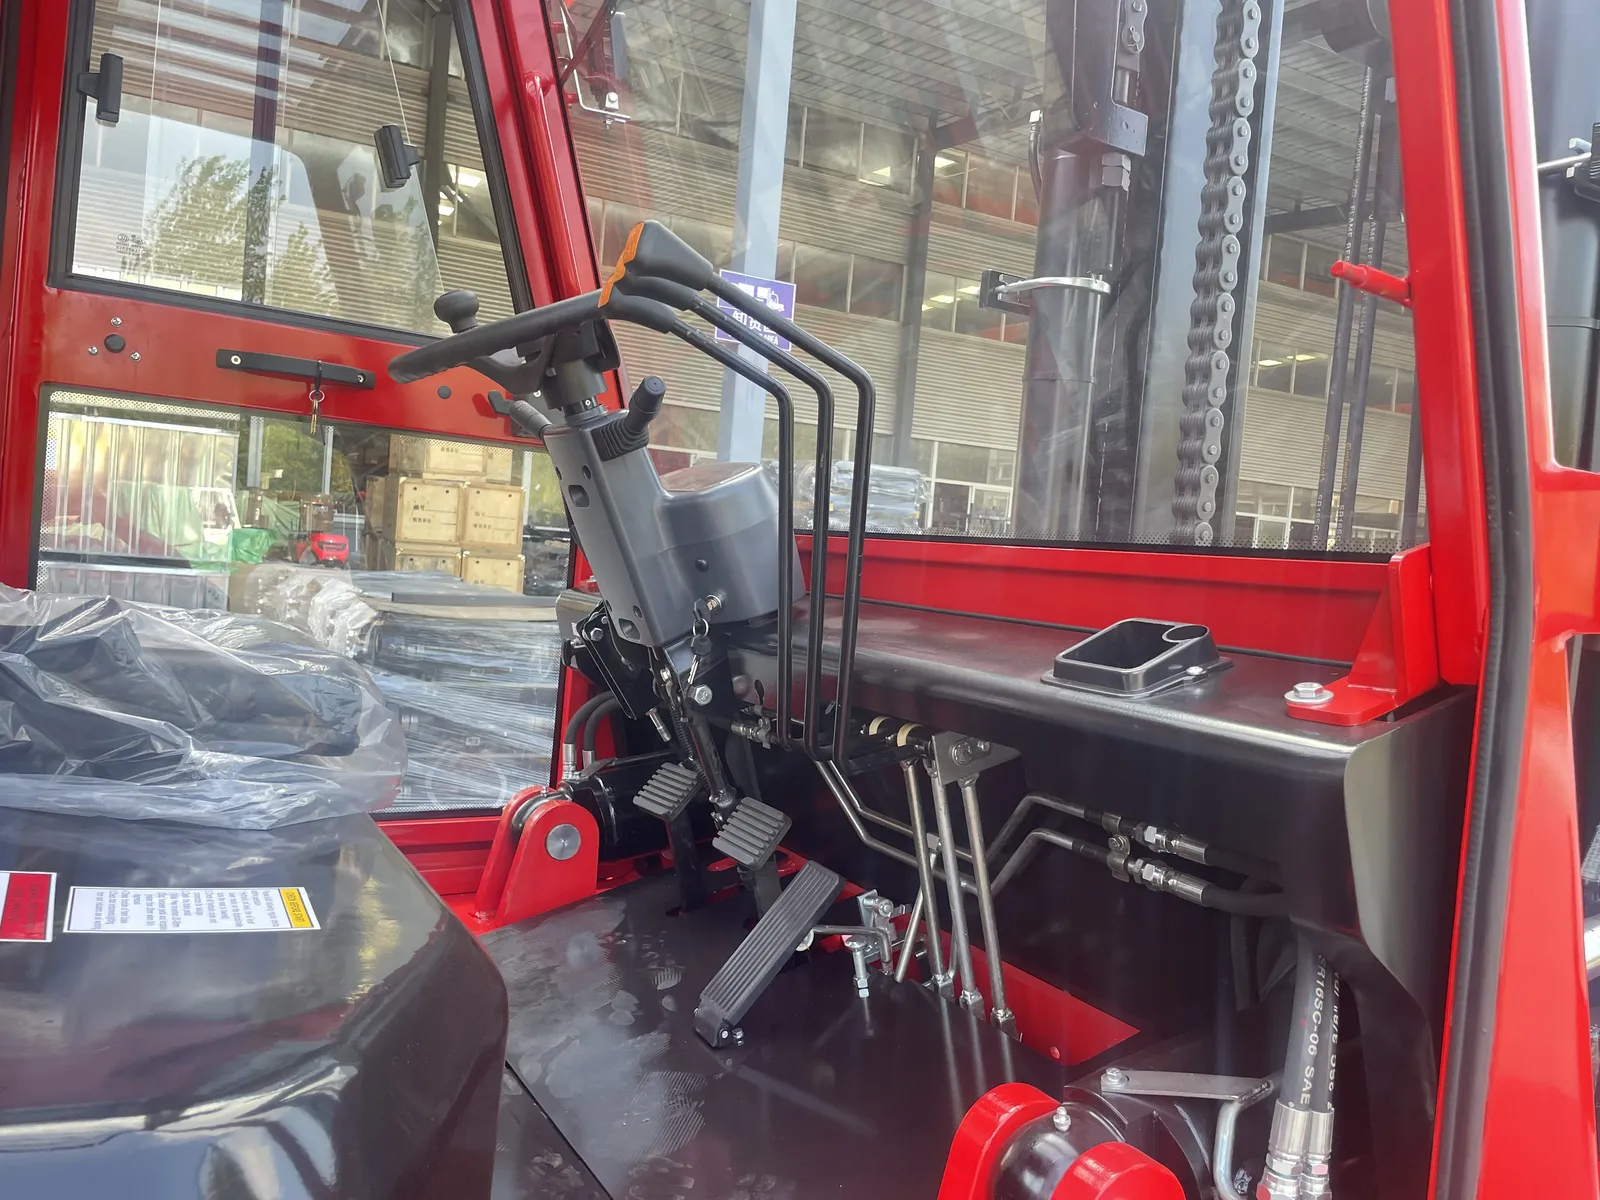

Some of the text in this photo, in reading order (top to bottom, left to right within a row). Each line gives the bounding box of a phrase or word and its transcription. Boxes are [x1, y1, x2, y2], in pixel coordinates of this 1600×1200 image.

[1347, 206, 1355, 237] FLAME
[1300, 954, 1326, 1105] SR16SC-06 SAE
